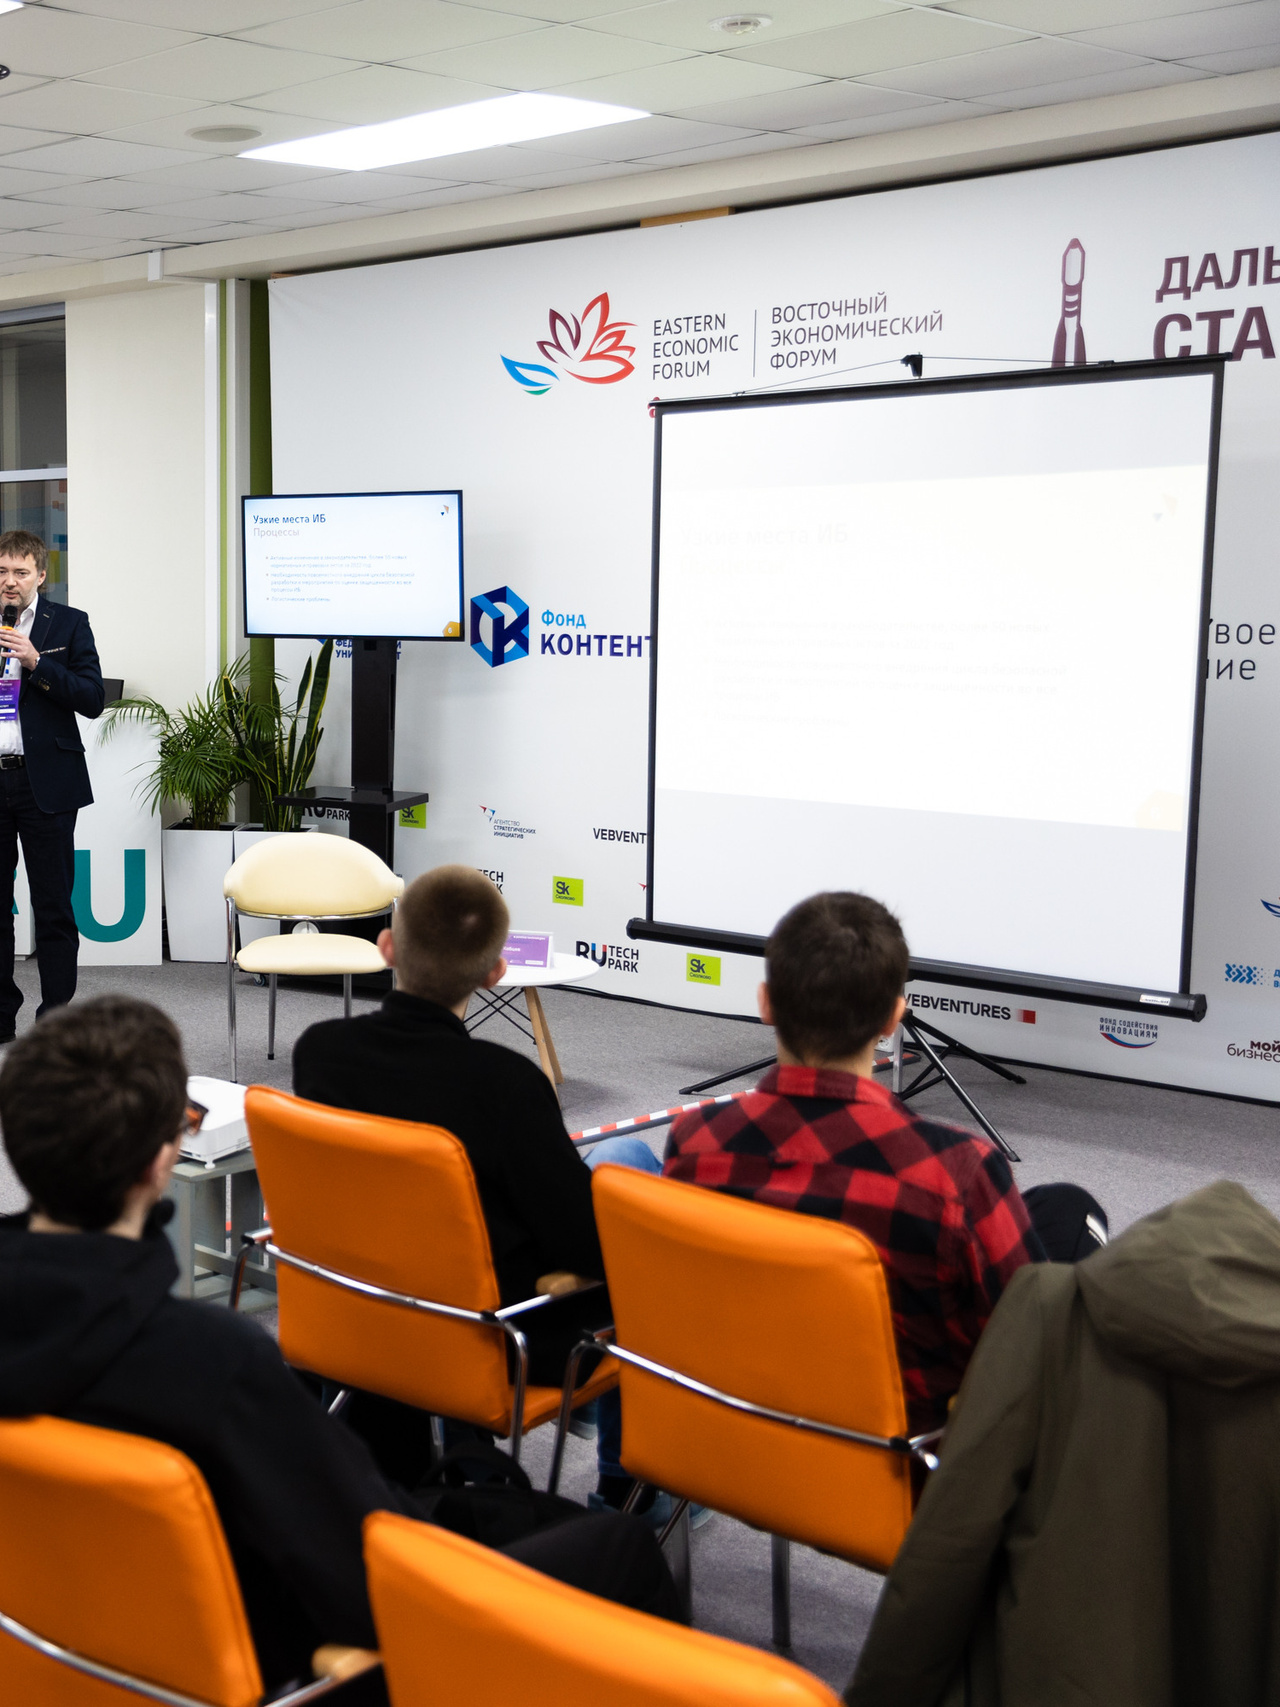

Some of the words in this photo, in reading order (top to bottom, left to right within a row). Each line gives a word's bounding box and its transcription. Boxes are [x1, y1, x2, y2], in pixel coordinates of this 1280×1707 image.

[1155, 246, 1280, 303] ДАЛЬ
[771, 291, 887, 324] ВОСТОЧНЫЙ
[653, 313, 726, 336] EASTERN
[770, 310, 943, 347] ЭКОНОМИЧЕСКИЙ
[1153, 306, 1276, 361] СТА
[653, 334, 739, 358] ECONOMIC
[770, 347, 836, 370] ФОРУМ
[652, 360, 710, 380] FORUM
[253, 515, 280, 524] Узкие
[282, 516, 310, 524] места
[312, 513, 326, 523] ИБ
[253, 527, 300, 539] Процессы
[541, 609, 587, 629] Фонд
[1209, 618, 1276, 645] вое
[1206, 659, 1256, 680] ие
[326, 808, 351, 821] PARK
[494, 818, 520, 827] АГЕНТСТВО
[494, 825, 536, 834] СТРАТЕГИЧЕСКИХ
[494, 831, 524, 839] ИНИЦИАТИВ
[593, 828, 647, 844] VEBVENT
[555, 881, 570, 895] Sk
[608, 945, 639, 960] TECH
[608, 958, 639, 973] PARK
[690, 959, 706, 974] Sk
[1099, 1017, 1117, 1026] ФОНД
[1119, 1019, 1158, 1031] СОДЕЙСТВИЯ
[1099, 1024, 1158, 1039] ИННОВАЦИЯМ
[1227, 1043, 1280, 1062] бизнес
